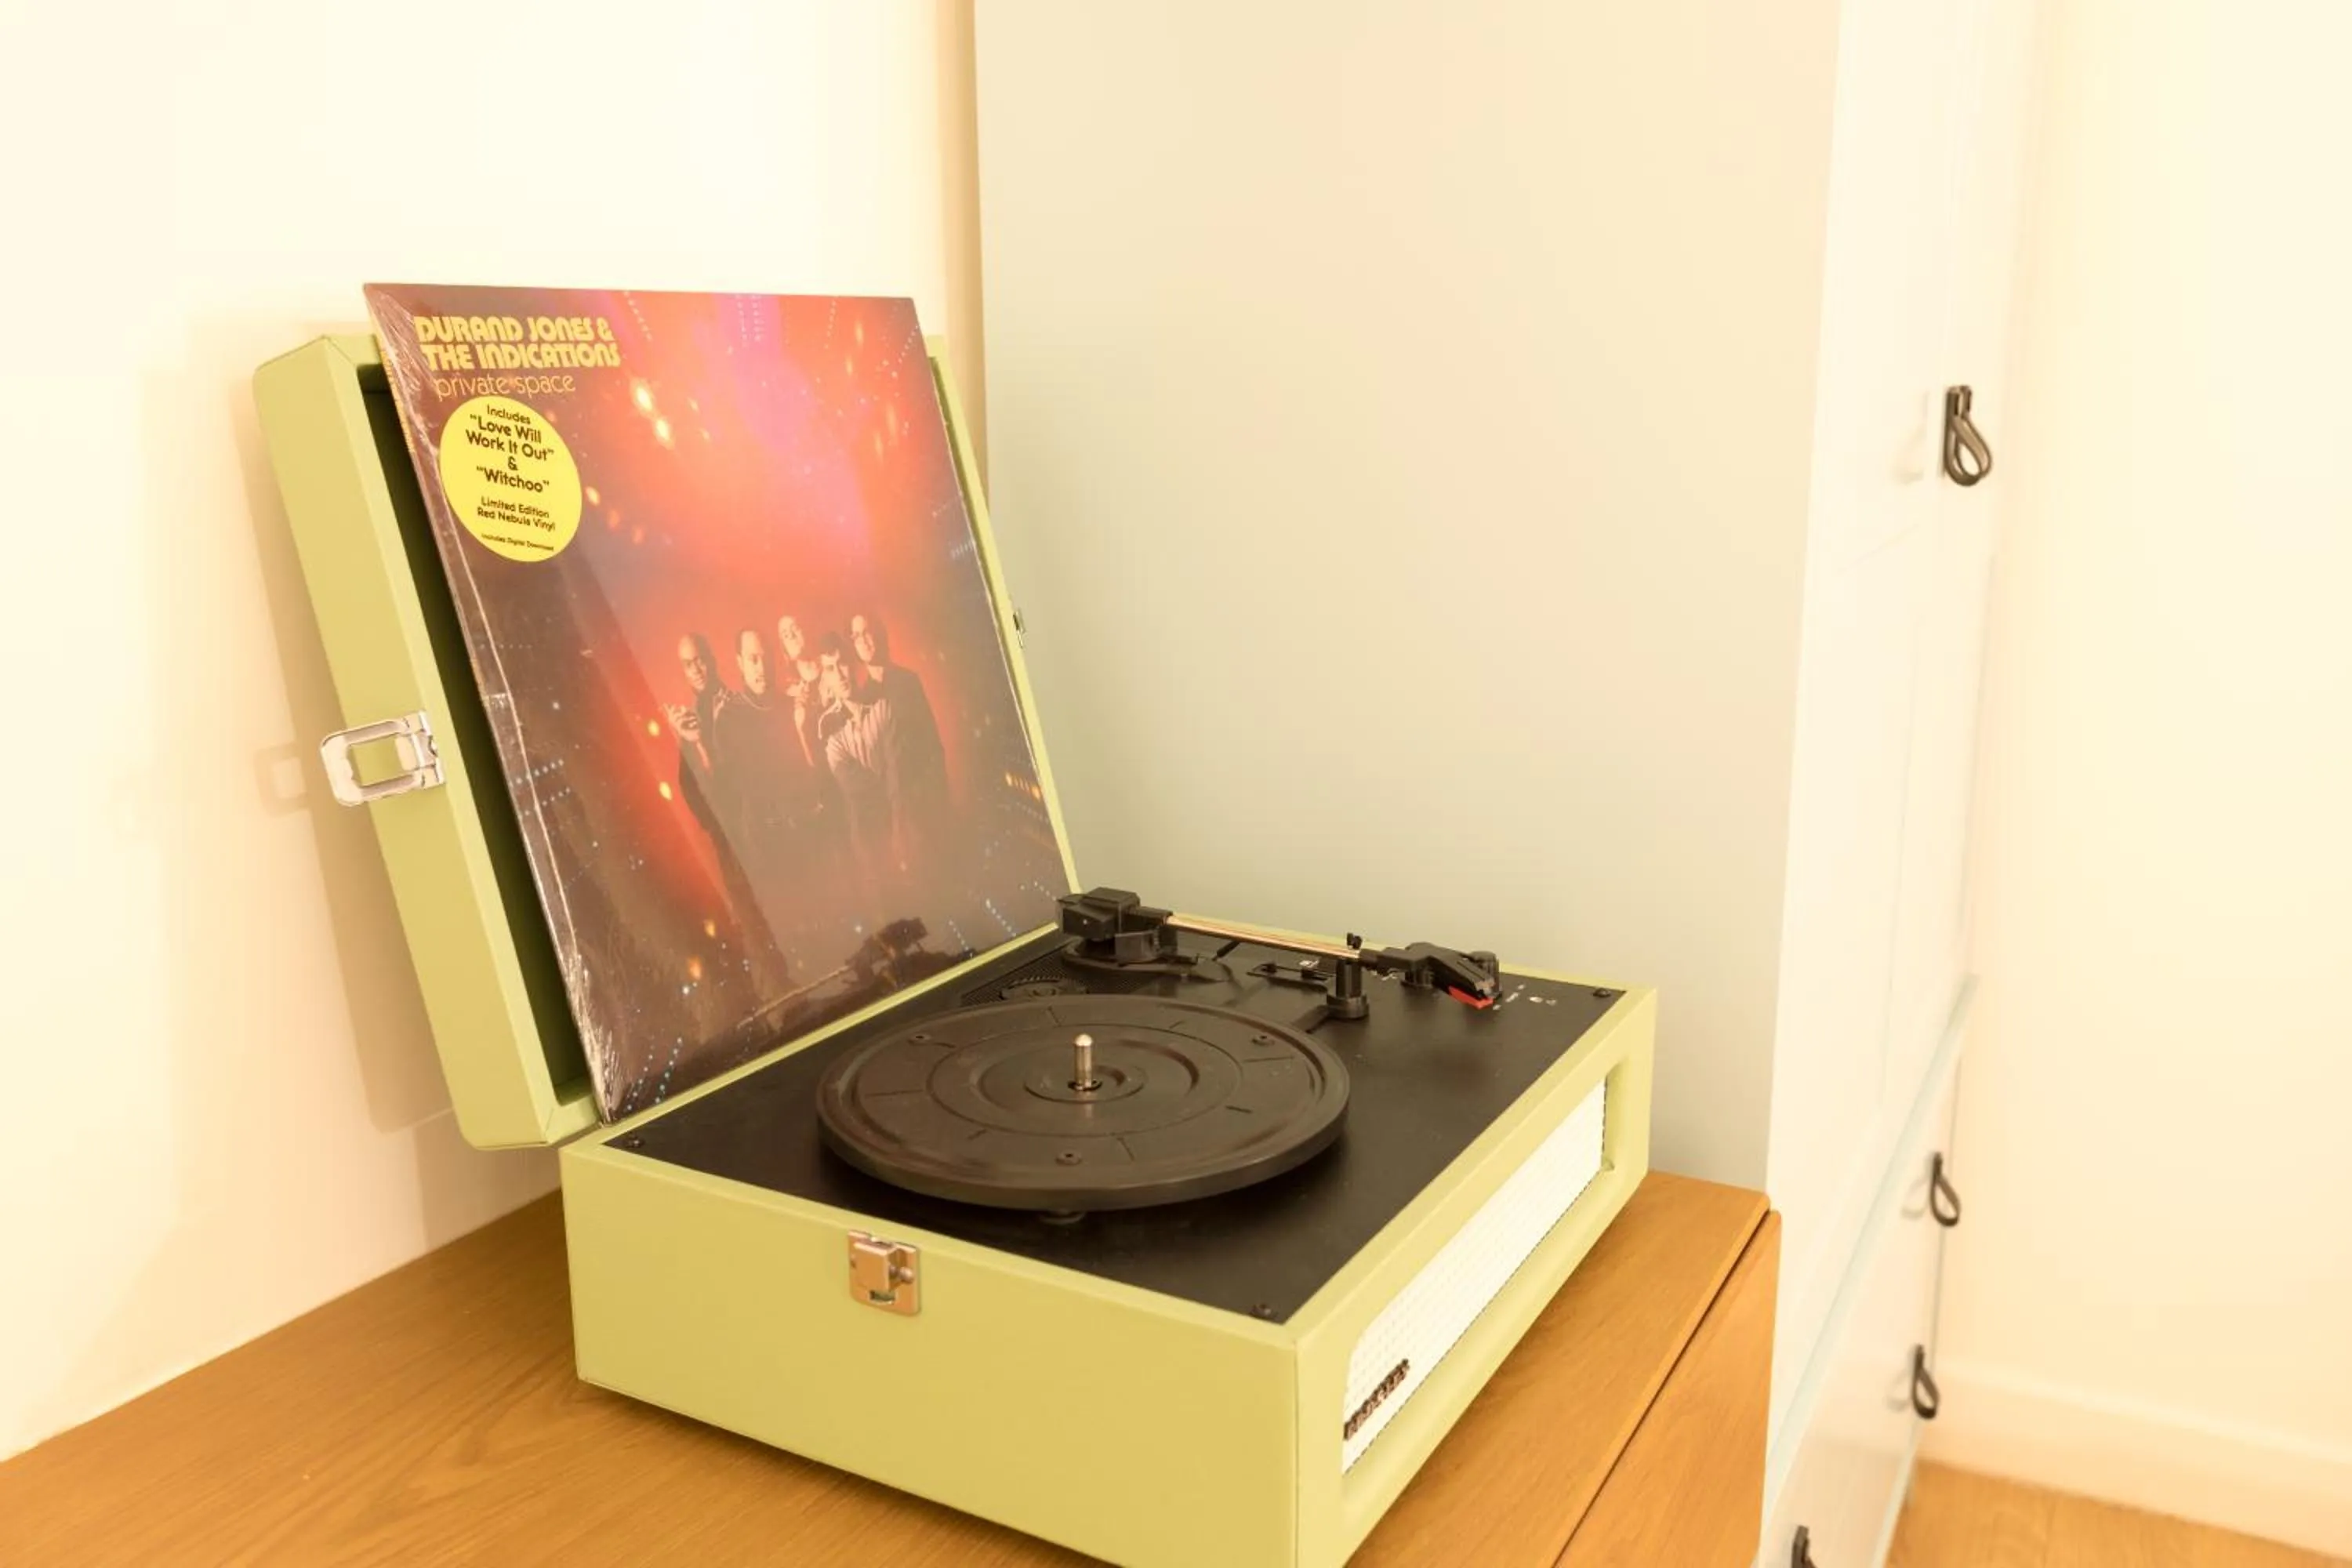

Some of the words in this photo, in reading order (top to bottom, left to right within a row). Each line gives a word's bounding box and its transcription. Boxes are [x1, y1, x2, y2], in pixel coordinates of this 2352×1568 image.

[414, 316, 524, 342] DURAND
[527, 317, 594, 342] JONES
[597, 318, 615, 341] &
[421, 344, 474, 371] THE
[476, 343, 621, 369] INDICATIONS
[434, 373, 510, 401] private
[517, 376, 575, 398] space
[487, 405, 531, 424] Includes
[466, 430, 505, 452] Work
[509, 440, 517, 454] It
[514, 425, 541, 444] Will
[507, 456, 518, 470] &
[477, 507, 495, 520] Red
[481, 496, 516, 512] Limited
[518, 504, 550, 518] Edition
